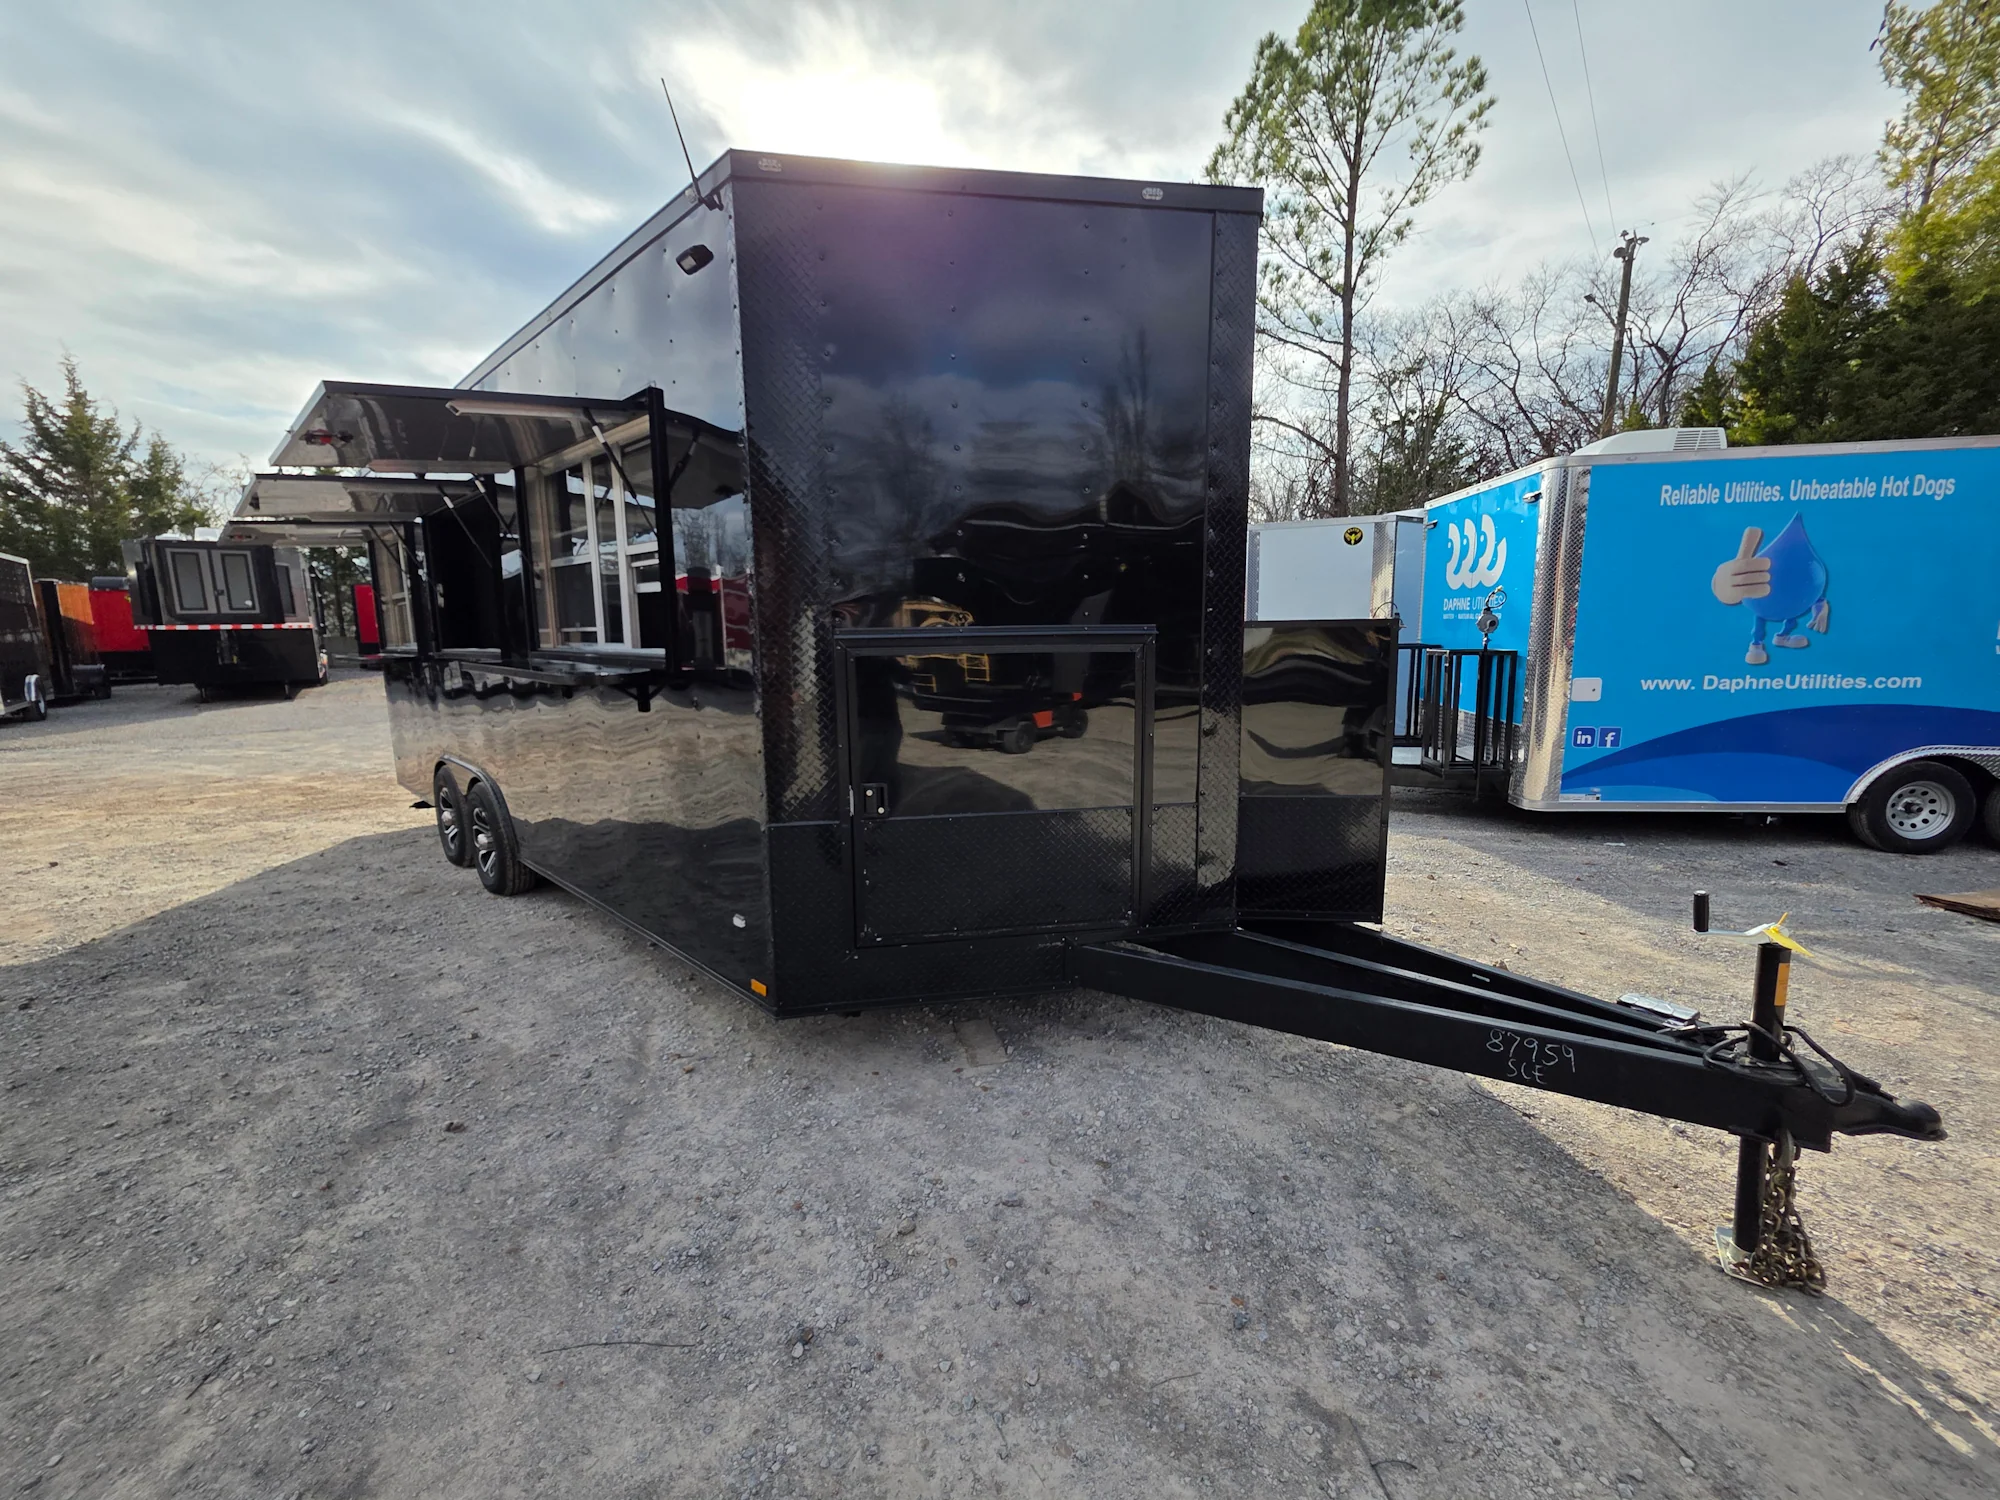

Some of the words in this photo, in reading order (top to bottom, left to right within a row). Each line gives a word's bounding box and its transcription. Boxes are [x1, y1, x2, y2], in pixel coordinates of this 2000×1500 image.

[1660, 484, 1720, 506] Reliable
[1724, 481, 1785, 504] Utilities.
[1789, 477, 1877, 501] Unbeatable
[1880, 475, 1910, 497] Hot
[1913, 474, 1956, 501] Dogs
[1443, 596, 1471, 610] DAPHNE
[1640, 678, 1696, 691] www.
[1702, 674, 1922, 693] DaphneUtilities.com
[1576, 730, 1592, 745] in
[1604, 731, 1617, 748] f
[1486, 1028, 1576, 1073] 87959
